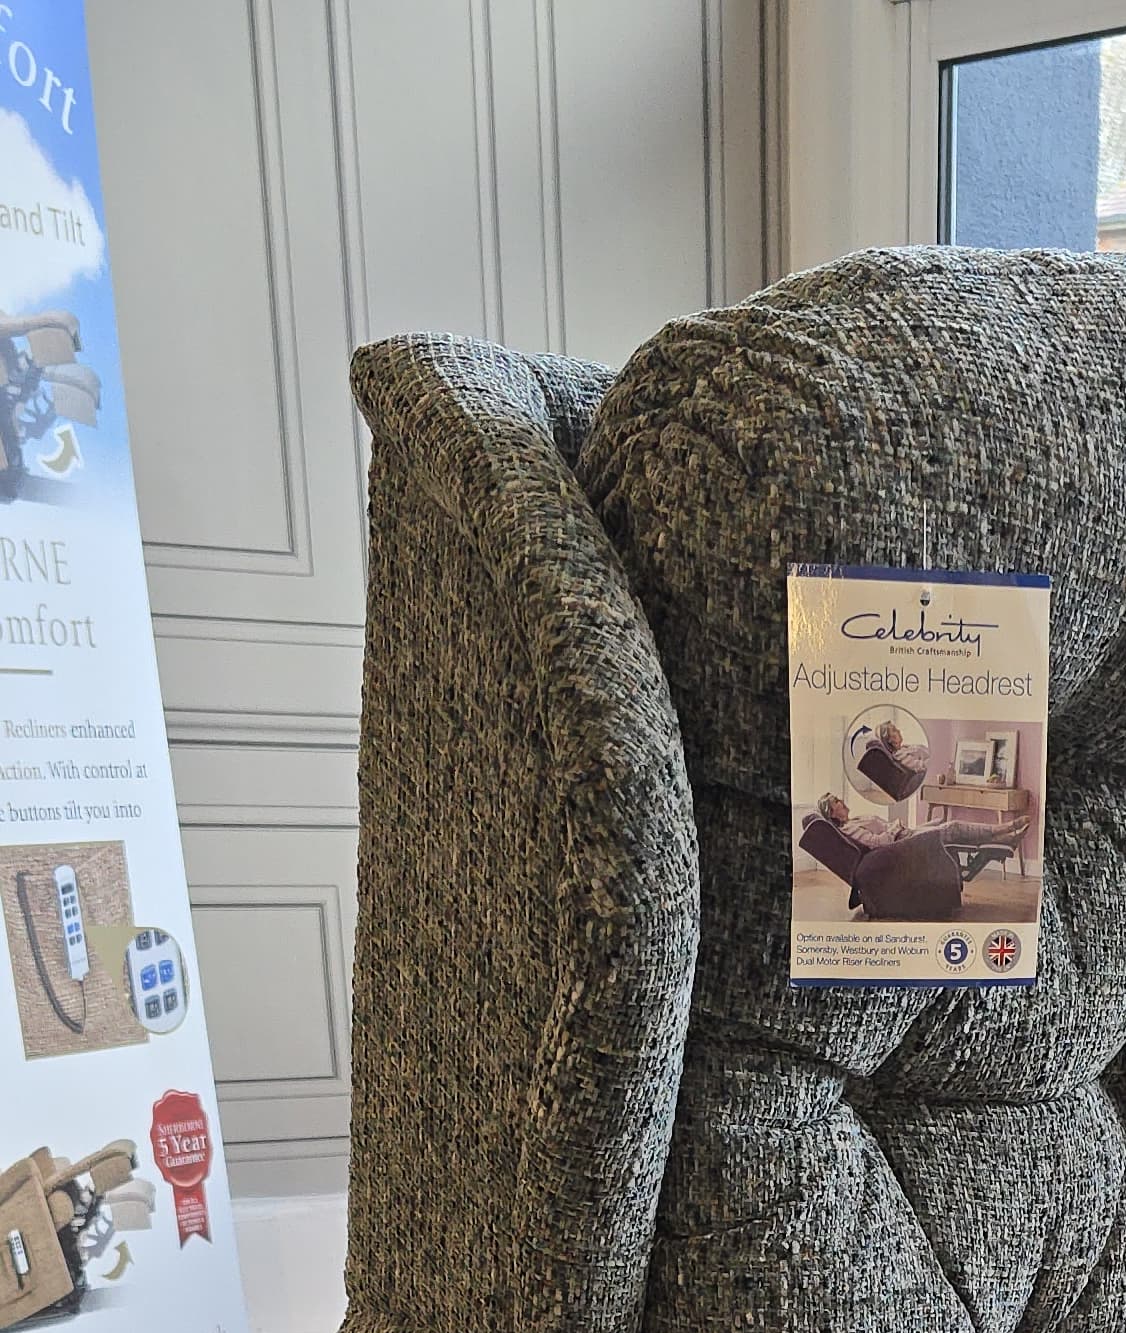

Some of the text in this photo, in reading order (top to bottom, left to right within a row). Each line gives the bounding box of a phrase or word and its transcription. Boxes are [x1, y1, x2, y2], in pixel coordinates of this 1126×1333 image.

[47, 206, 85, 247] Tilt
[841, 609, 999, 657] Celebrity
[889, 646, 972, 658] British Craftsmanship
[793, 662, 1032, 697] Adjustable Headrest
[4, 719, 136, 739] Recliners enhanced
[48, 760, 80, 780] With
[85, 758, 132, 779] control
[136, 764, 148, 779] at
[8, 801, 62, 822] buttons
[64, 800, 83, 820] tilt
[84, 805, 111, 824] you
[114, 801, 142, 818] into
[796, 932, 824, 943] Option
[825, 933, 860, 943] available
[863, 935, 872, 943] on
[875, 934, 884, 943] all
[841, 945, 879, 956] Westbury
[881, 946, 896, 955] and
[898, 946, 929, 956] Woburn
[950, 943, 961, 961] 5
[796, 956, 901, 967] Dual Motor Riser Recliners
[159, 1134, 207, 1157] 5 Year
